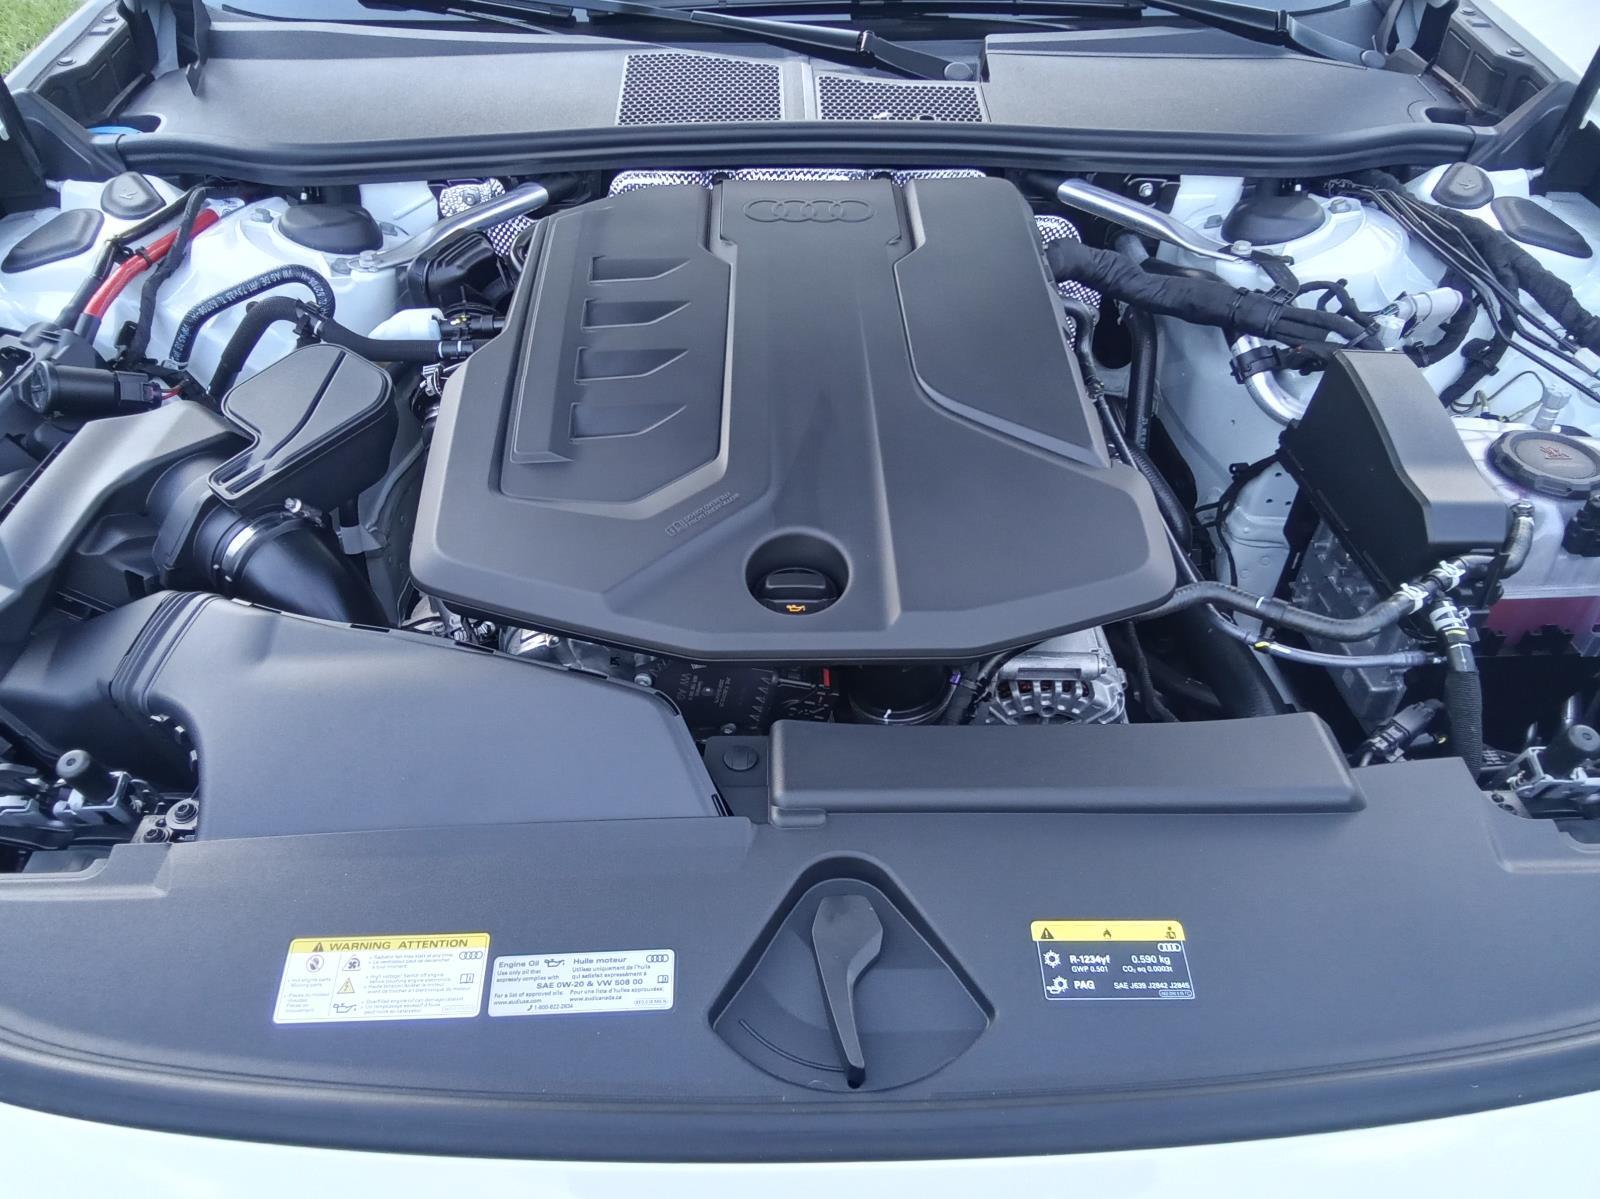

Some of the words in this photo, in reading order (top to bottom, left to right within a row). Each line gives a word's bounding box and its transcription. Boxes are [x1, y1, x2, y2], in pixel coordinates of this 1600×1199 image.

[329, 941, 392, 951] WARNING
[398, 939, 469, 950] ATTENTION
[498, 961, 526, 969] Engine
[528, 959, 540, 967] Oil
[573, 957, 594, 965] Huile
[1070, 954, 1110, 966] R-1234yf
[1131, 955, 1157, 964] 0.590
[1159, 955, 1171, 965] kg
[1071, 965, 1089, 973] GWP
[1090, 965, 1108, 973] 0.501
[596, 979, 613, 987] VW
[614, 978, 630, 986] 508
[1074, 980, 1095, 990] PAG
[1113, 981, 1129, 990] SAE
[1130, 981, 1146, 990] J639
[1148, 981, 1168, 989] J2842
